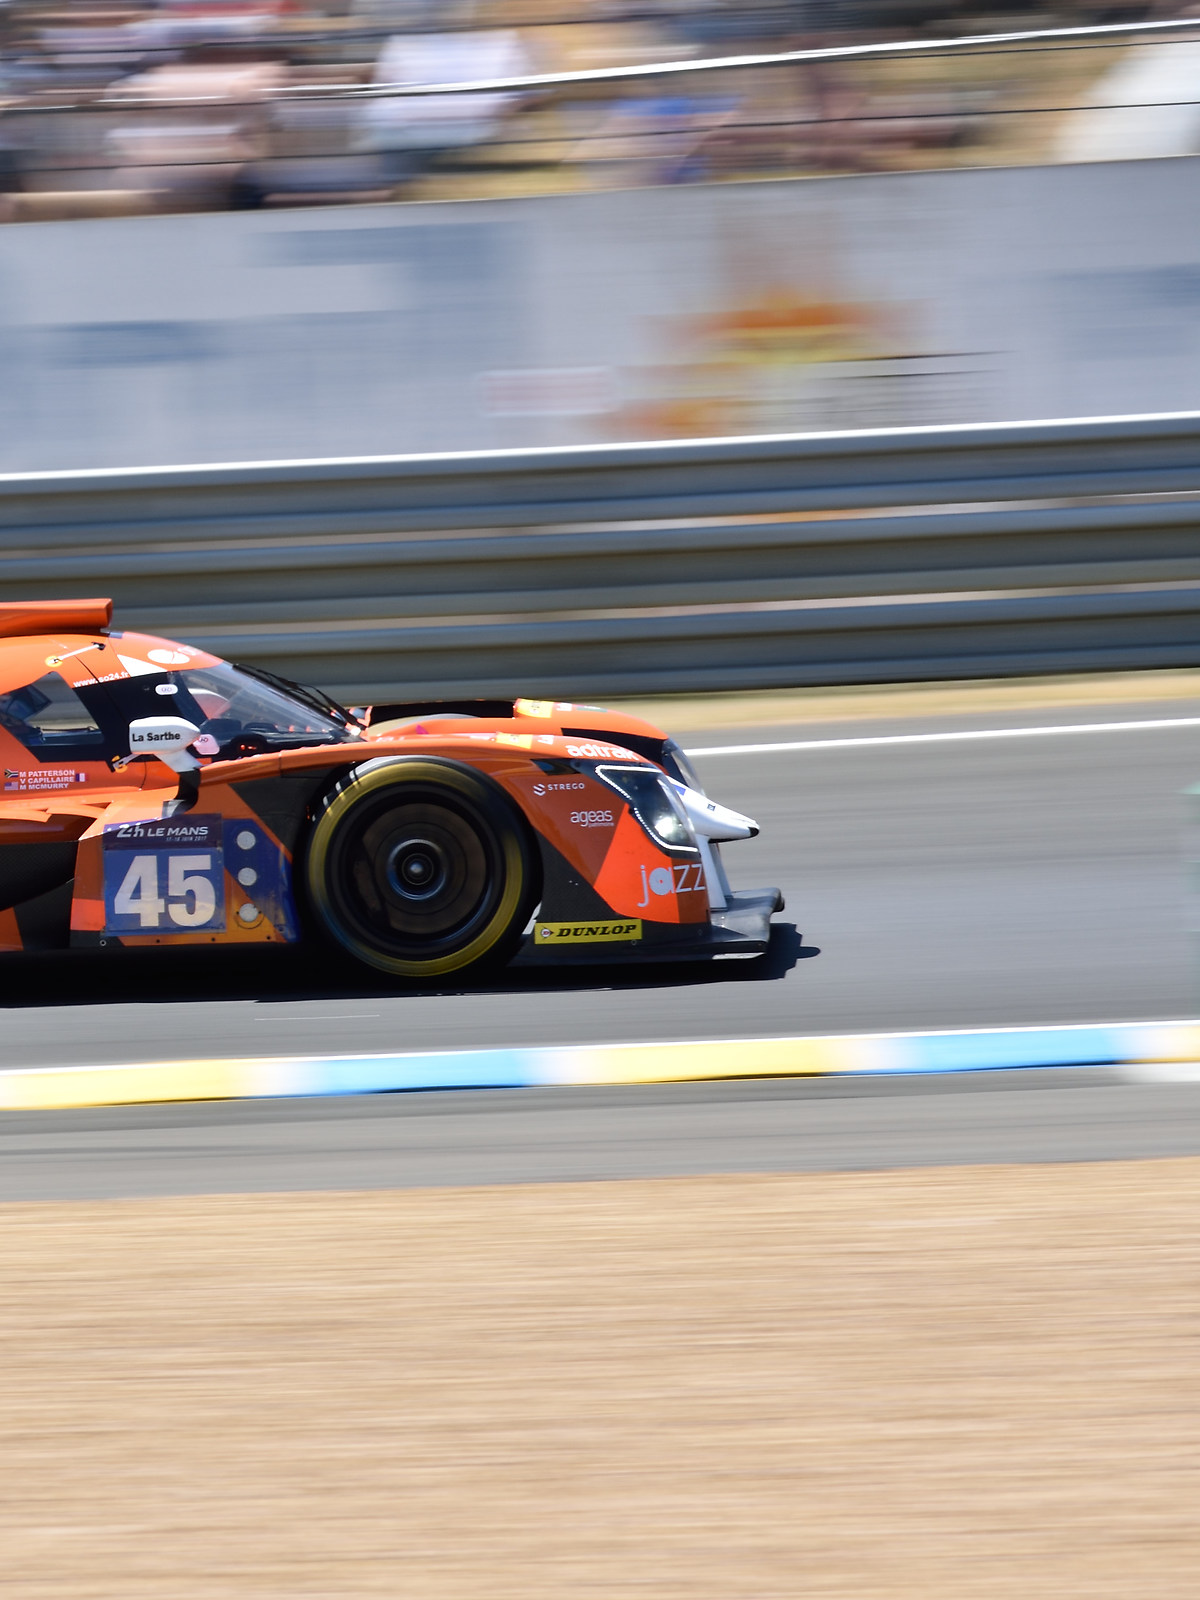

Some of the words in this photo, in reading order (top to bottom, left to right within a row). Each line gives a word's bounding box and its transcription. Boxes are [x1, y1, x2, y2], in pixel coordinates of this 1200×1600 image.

[73, 671, 129, 688] www.so24.fr
[132, 733, 144, 742] La
[147, 731, 181, 742] Sarthe
[28, 769, 75, 777] PATTERSON
[570, 810, 613, 827] ageas
[147, 827, 165, 837] LE
[167, 826, 209, 836] MANS
[114, 855, 216, 927] 45
[637, 864, 706, 907] jazz
[556, 924, 636, 938] DUNLOP
